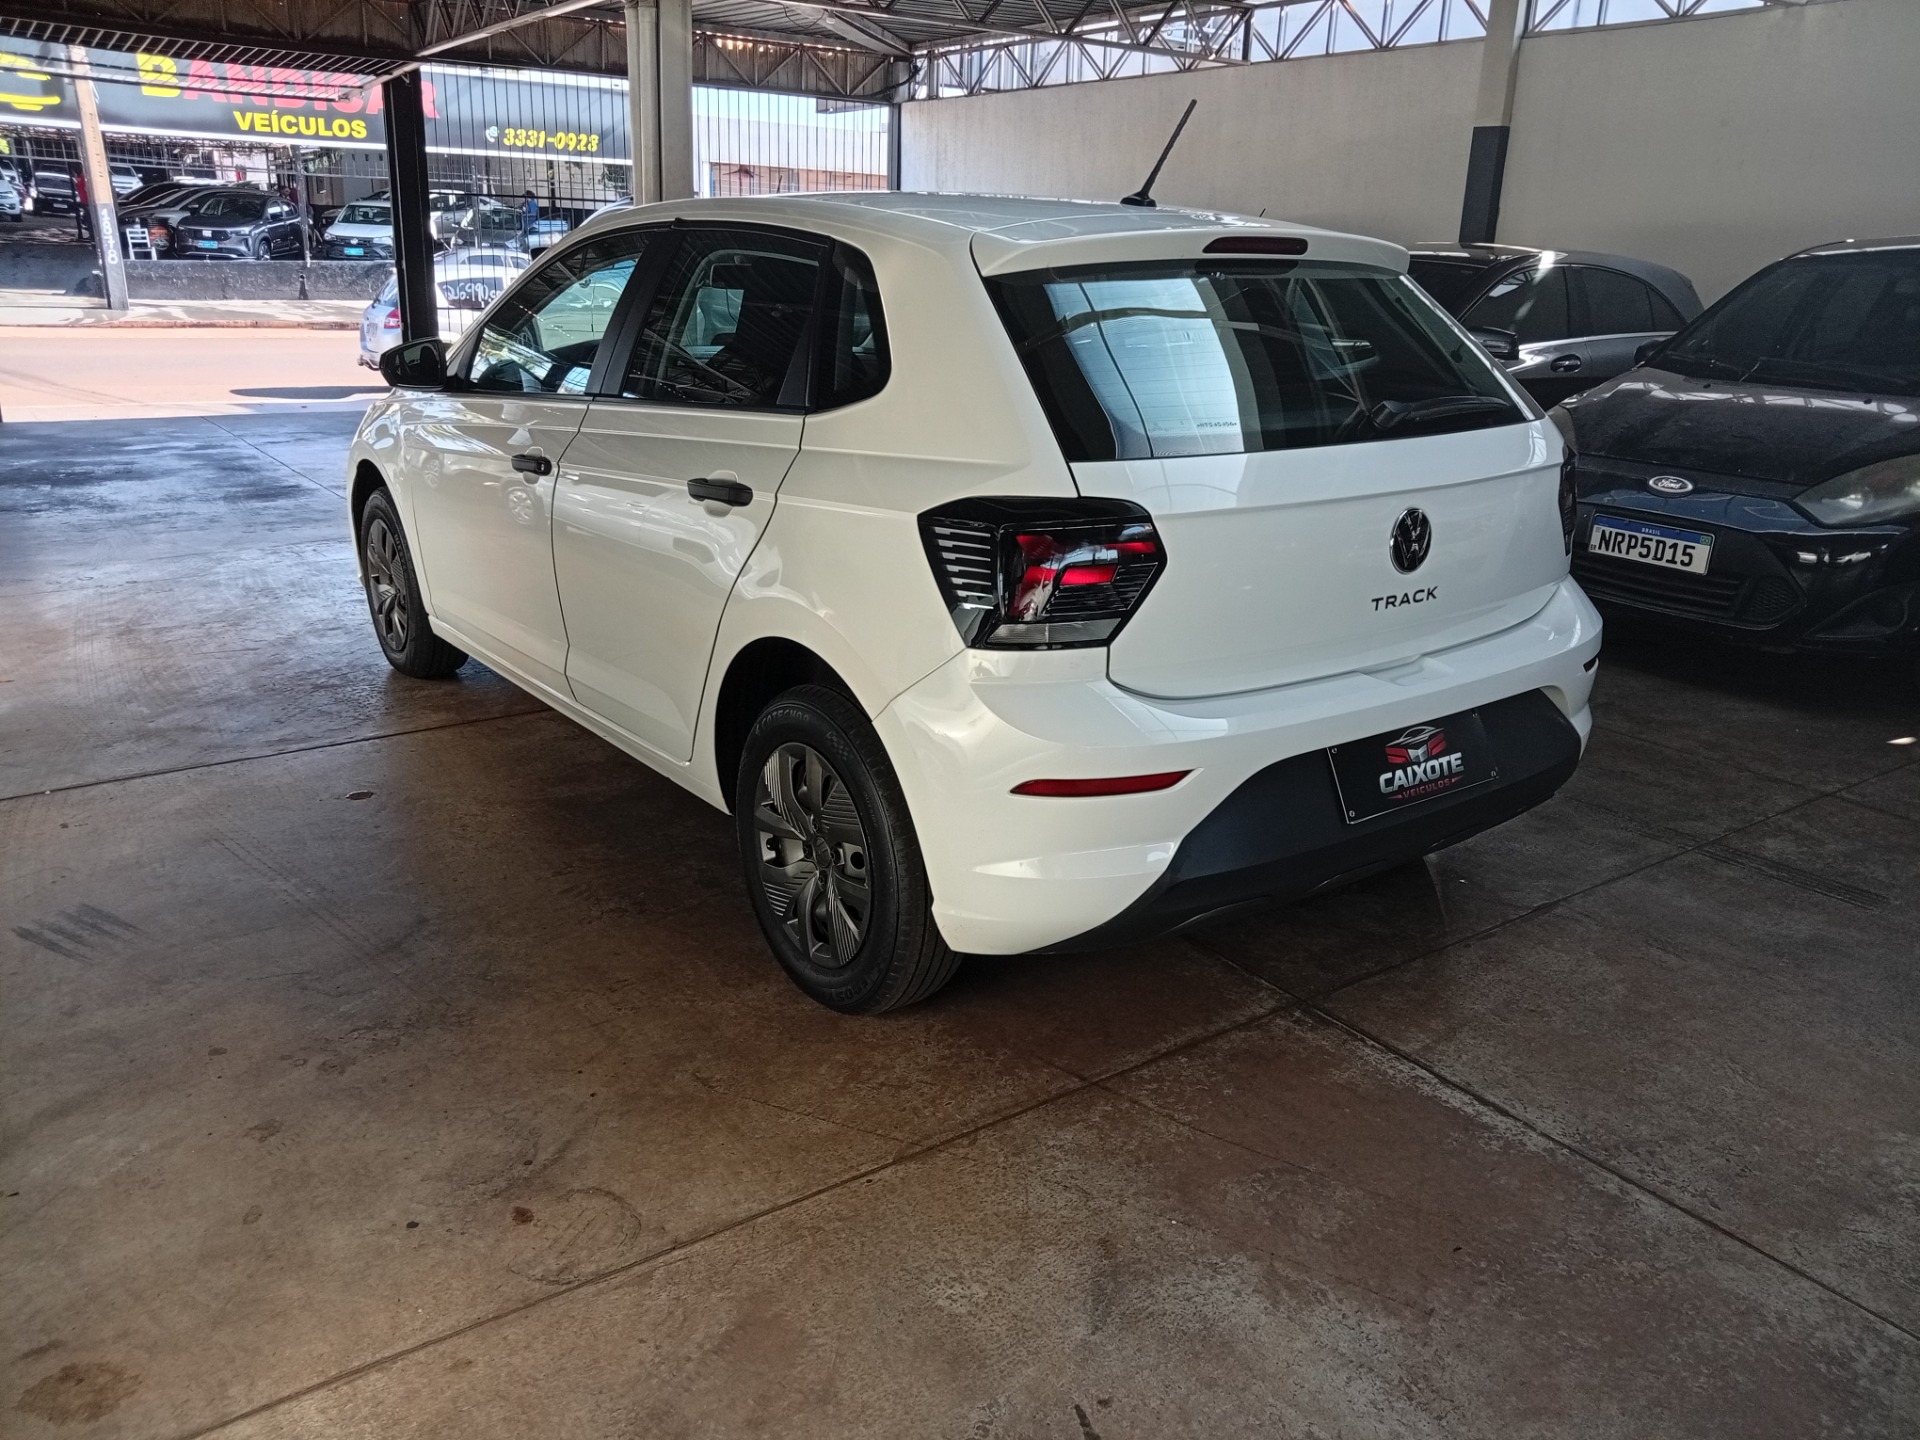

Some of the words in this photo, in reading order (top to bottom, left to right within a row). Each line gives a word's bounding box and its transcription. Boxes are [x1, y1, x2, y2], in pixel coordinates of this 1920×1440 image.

[233, 110, 367, 139] VEÍCULOS
[503, 127, 599, 152] 3331-0928
[1641, 527, 1661, 536] BRASIL
[1597, 529, 1696, 567] NRP5D15
[1371, 586, 1439, 611] TRACK
[1379, 752, 1464, 794] CAIXOTE
[1402, 778, 1451, 798] VEICULOS
